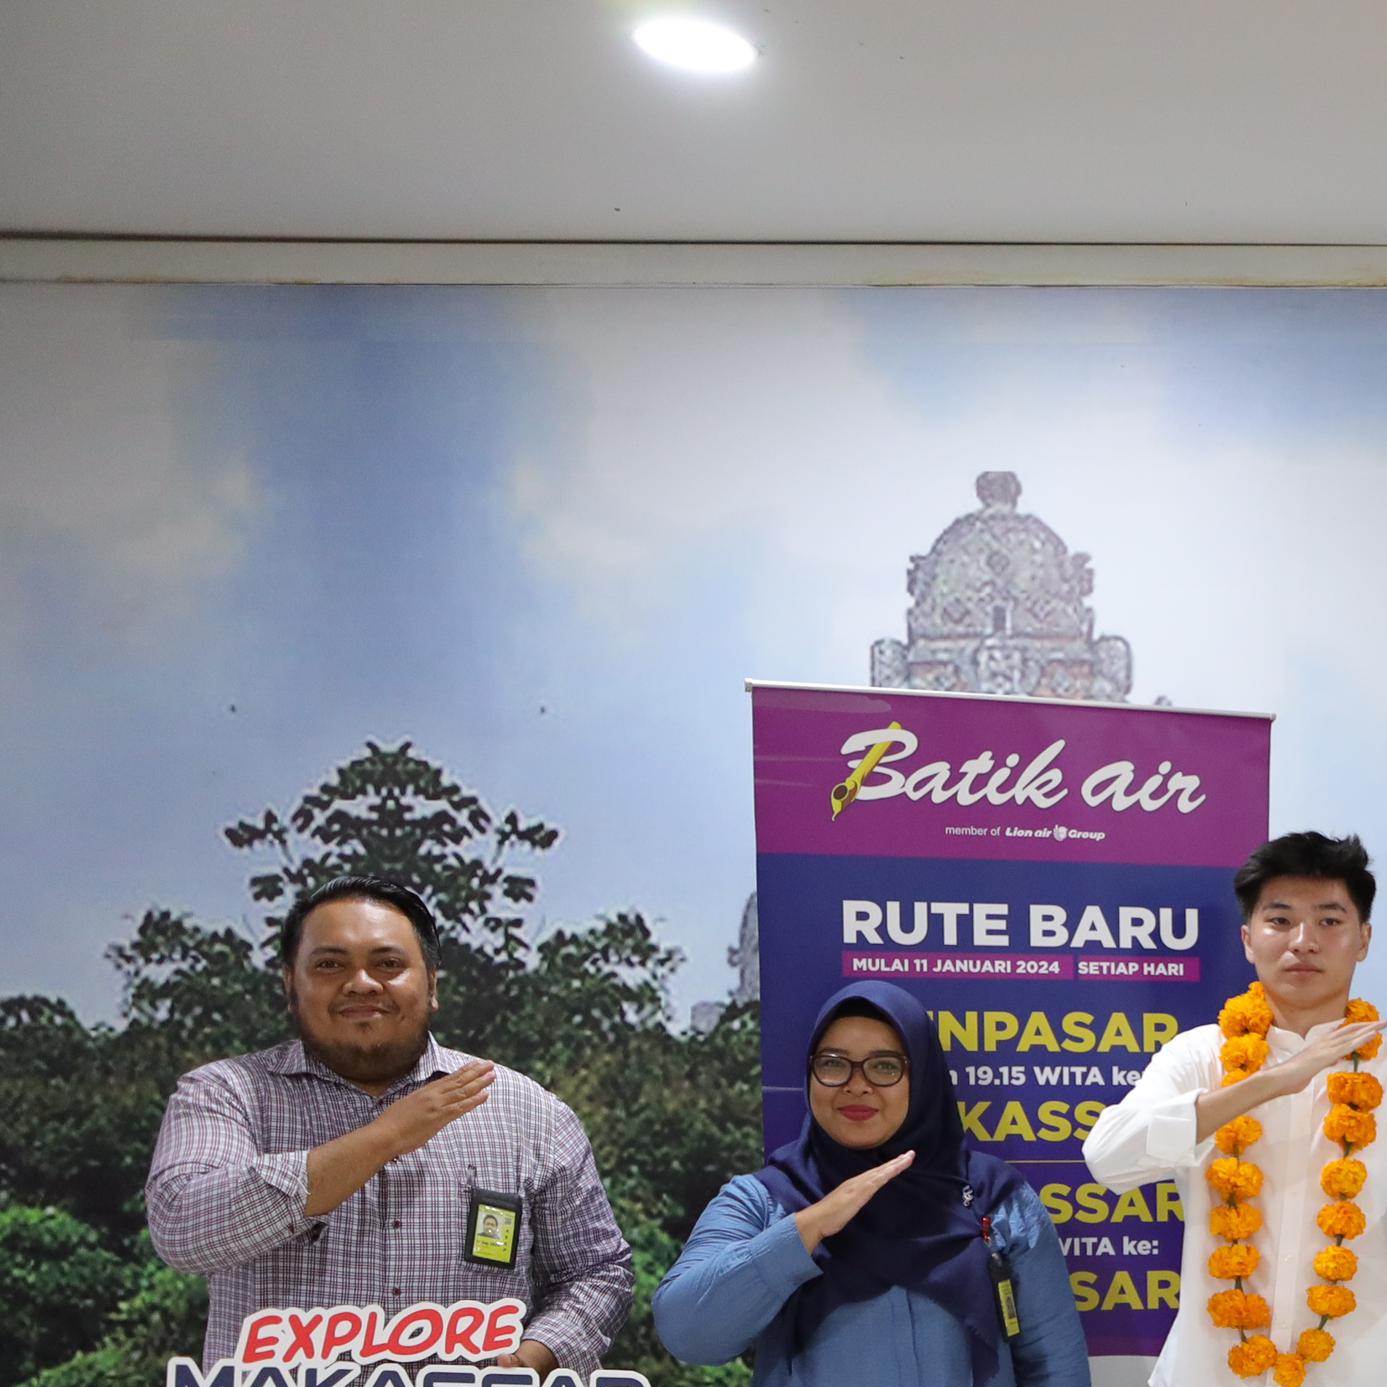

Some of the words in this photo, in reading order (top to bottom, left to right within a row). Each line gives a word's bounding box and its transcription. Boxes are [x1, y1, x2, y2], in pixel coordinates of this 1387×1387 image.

[838, 726, 1069, 811] Batik
[1081, 760, 1206, 814] air
[944, 825, 987, 837] member
[989, 825, 1002, 837] of
[1004, 826, 1033, 838] Lion
[1033, 828, 1053, 839] air
[1067, 828, 1106, 842] Group
[842, 899, 1010, 947] RUTE
[1030, 905, 1199, 951] BARU
[852, 958, 909, 973] MULAI
[914, 960, 928, 973] 11
[932, 959, 1012, 975] JANUARI
[1016, 960, 1061, 976] 2024
[1078, 961, 1140, 977] SETIAP
[1142, 962, 1184, 977] HARI
[928, 1010, 1180, 1053] NPASAR
[965, 1065, 1026, 1086] 19.15
[1033, 1065, 1106, 1086] WITA
[1039, 1182, 1185, 1225] SSAR
[1122, 1235, 1160, 1256] ke:
[242, 1304, 520, 1364] EXPLORE
